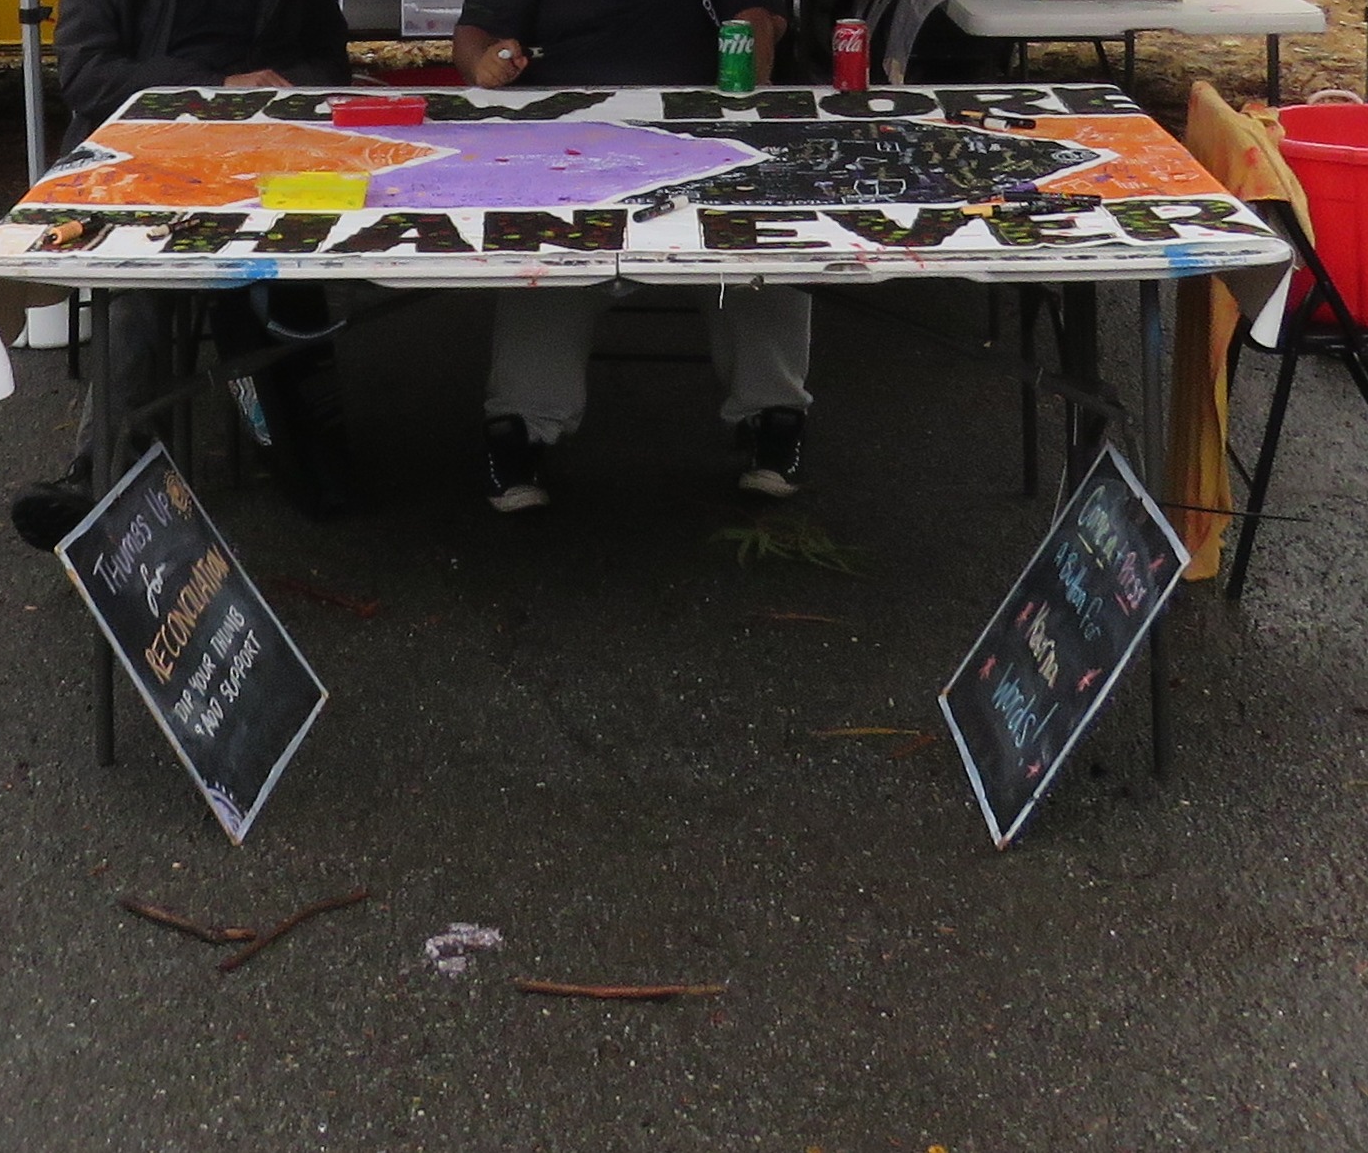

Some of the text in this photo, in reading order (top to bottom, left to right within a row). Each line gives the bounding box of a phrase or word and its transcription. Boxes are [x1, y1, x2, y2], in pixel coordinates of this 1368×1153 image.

[7, 196, 1283, 255] THAN EVER
[219, 630, 263, 703] SUPPORT
